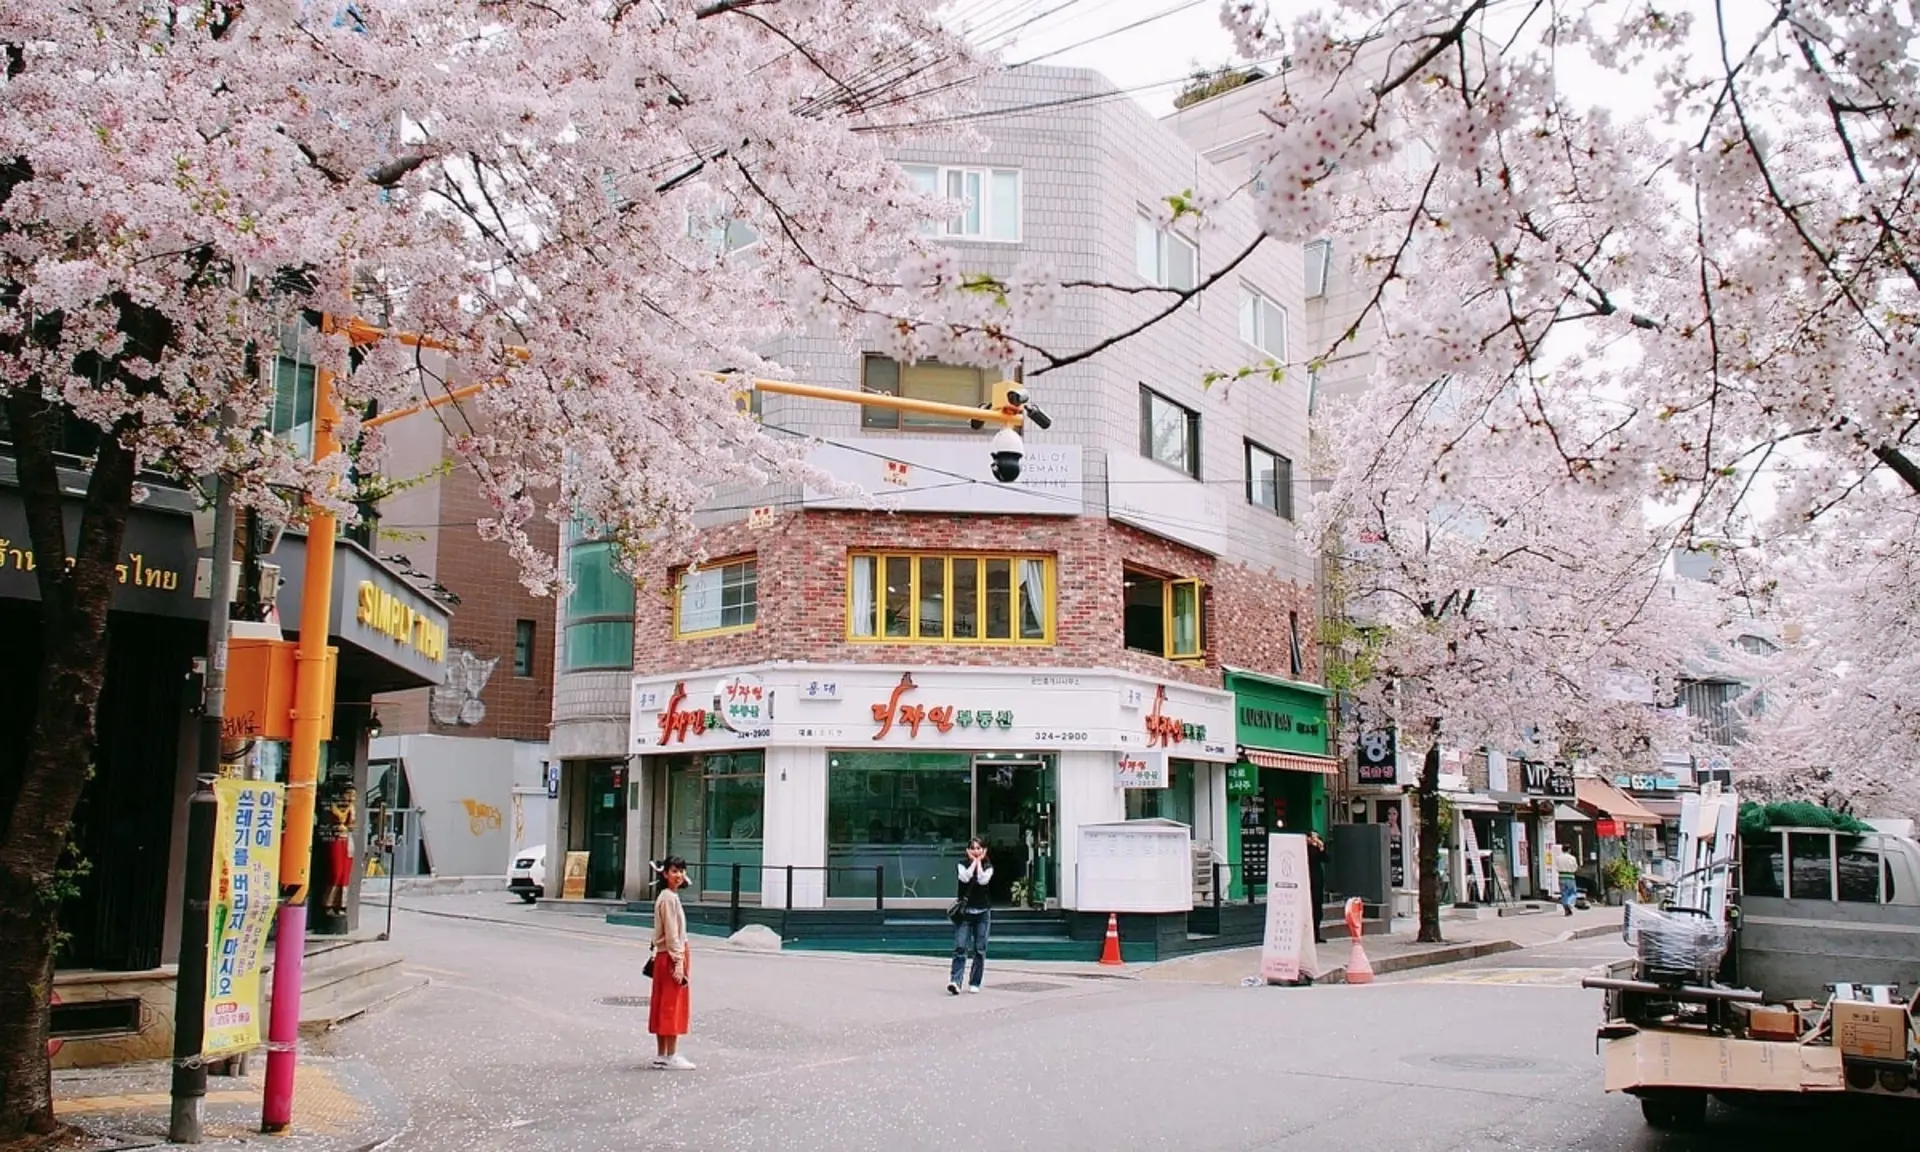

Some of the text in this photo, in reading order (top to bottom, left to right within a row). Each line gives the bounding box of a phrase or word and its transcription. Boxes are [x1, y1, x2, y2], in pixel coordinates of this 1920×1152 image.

[1021, 464, 1068, 473] DEMAIN
[1051, 453, 1066, 461] OF
[357, 580, 415, 645] SIMPLY
[870, 671, 1014, 741] 디자인 부동산
[1034, 731, 1088, 741] 324-2900
[1526, 764, 1550, 787] VIP
[1631, 774, 1655, 791] GS25
[233, 789, 254, 867] 쓰레기를
[255, 791, 276, 848] 이곳에
[229, 873, 249, 930] 버리지
[218, 937, 238, 996] 마시오
